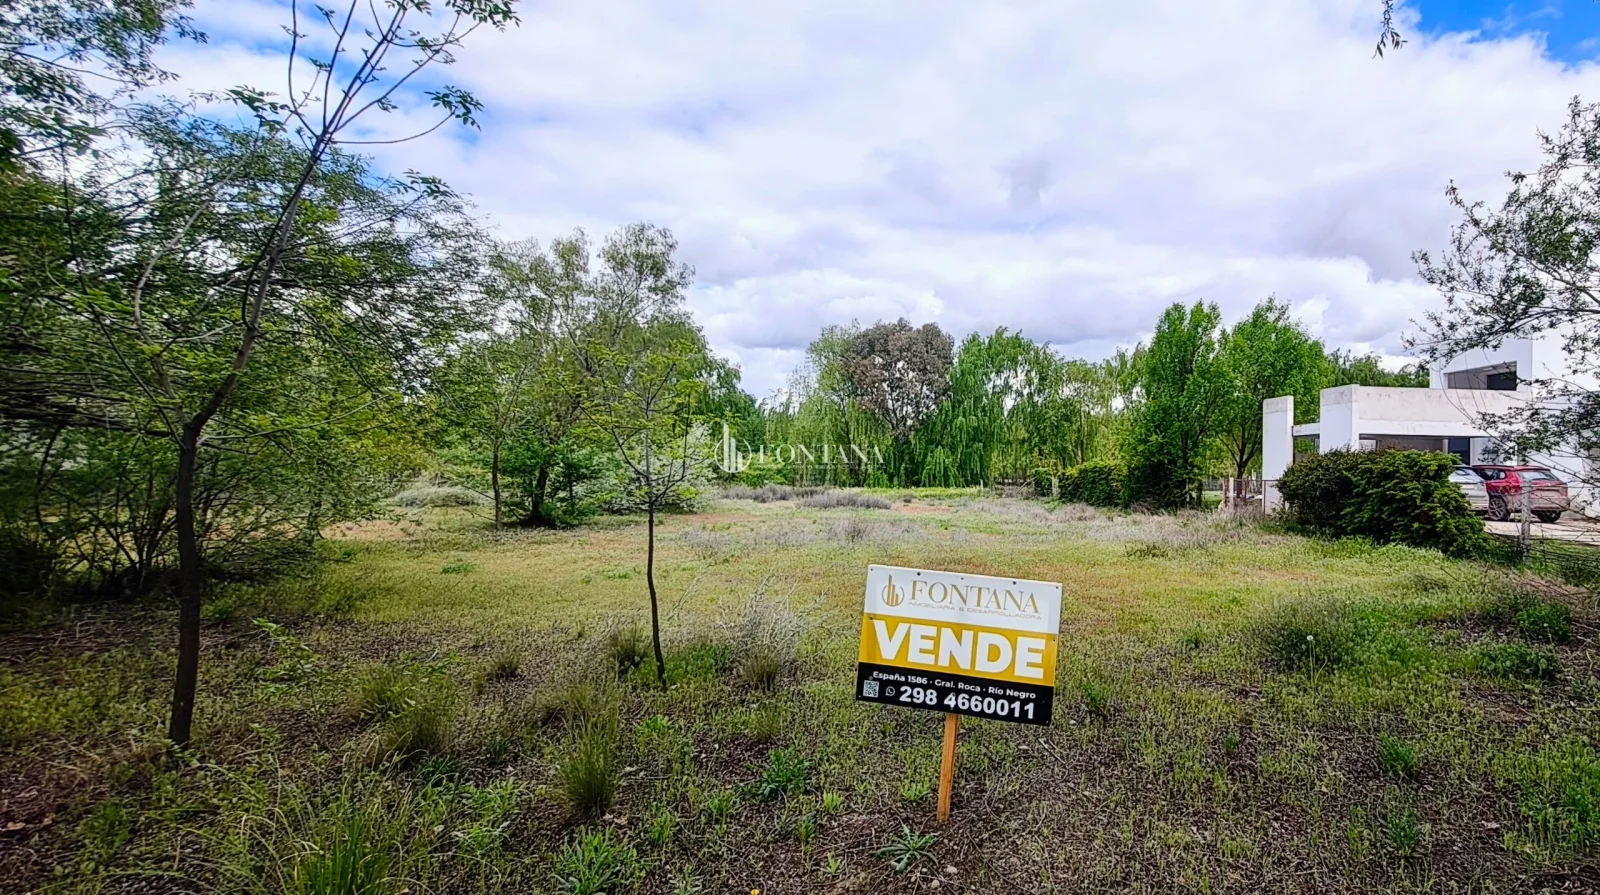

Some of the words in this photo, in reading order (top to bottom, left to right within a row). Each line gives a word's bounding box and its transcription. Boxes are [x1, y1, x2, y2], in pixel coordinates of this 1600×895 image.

[909, 580, 1040, 614] FONTANA
[873, 619, 1046, 679] VENDE
[873, 671, 905, 683] España
[908, 675, 927, 685] 1586
[935, 679, 955, 688] Gral.
[958, 682, 980, 692] Roca
[988, 686, 1003, 695] Río
[1006, 688, 1036, 699] Negro
[899, 685, 937, 705] 298
[944, 693, 1034, 719] 4660011
